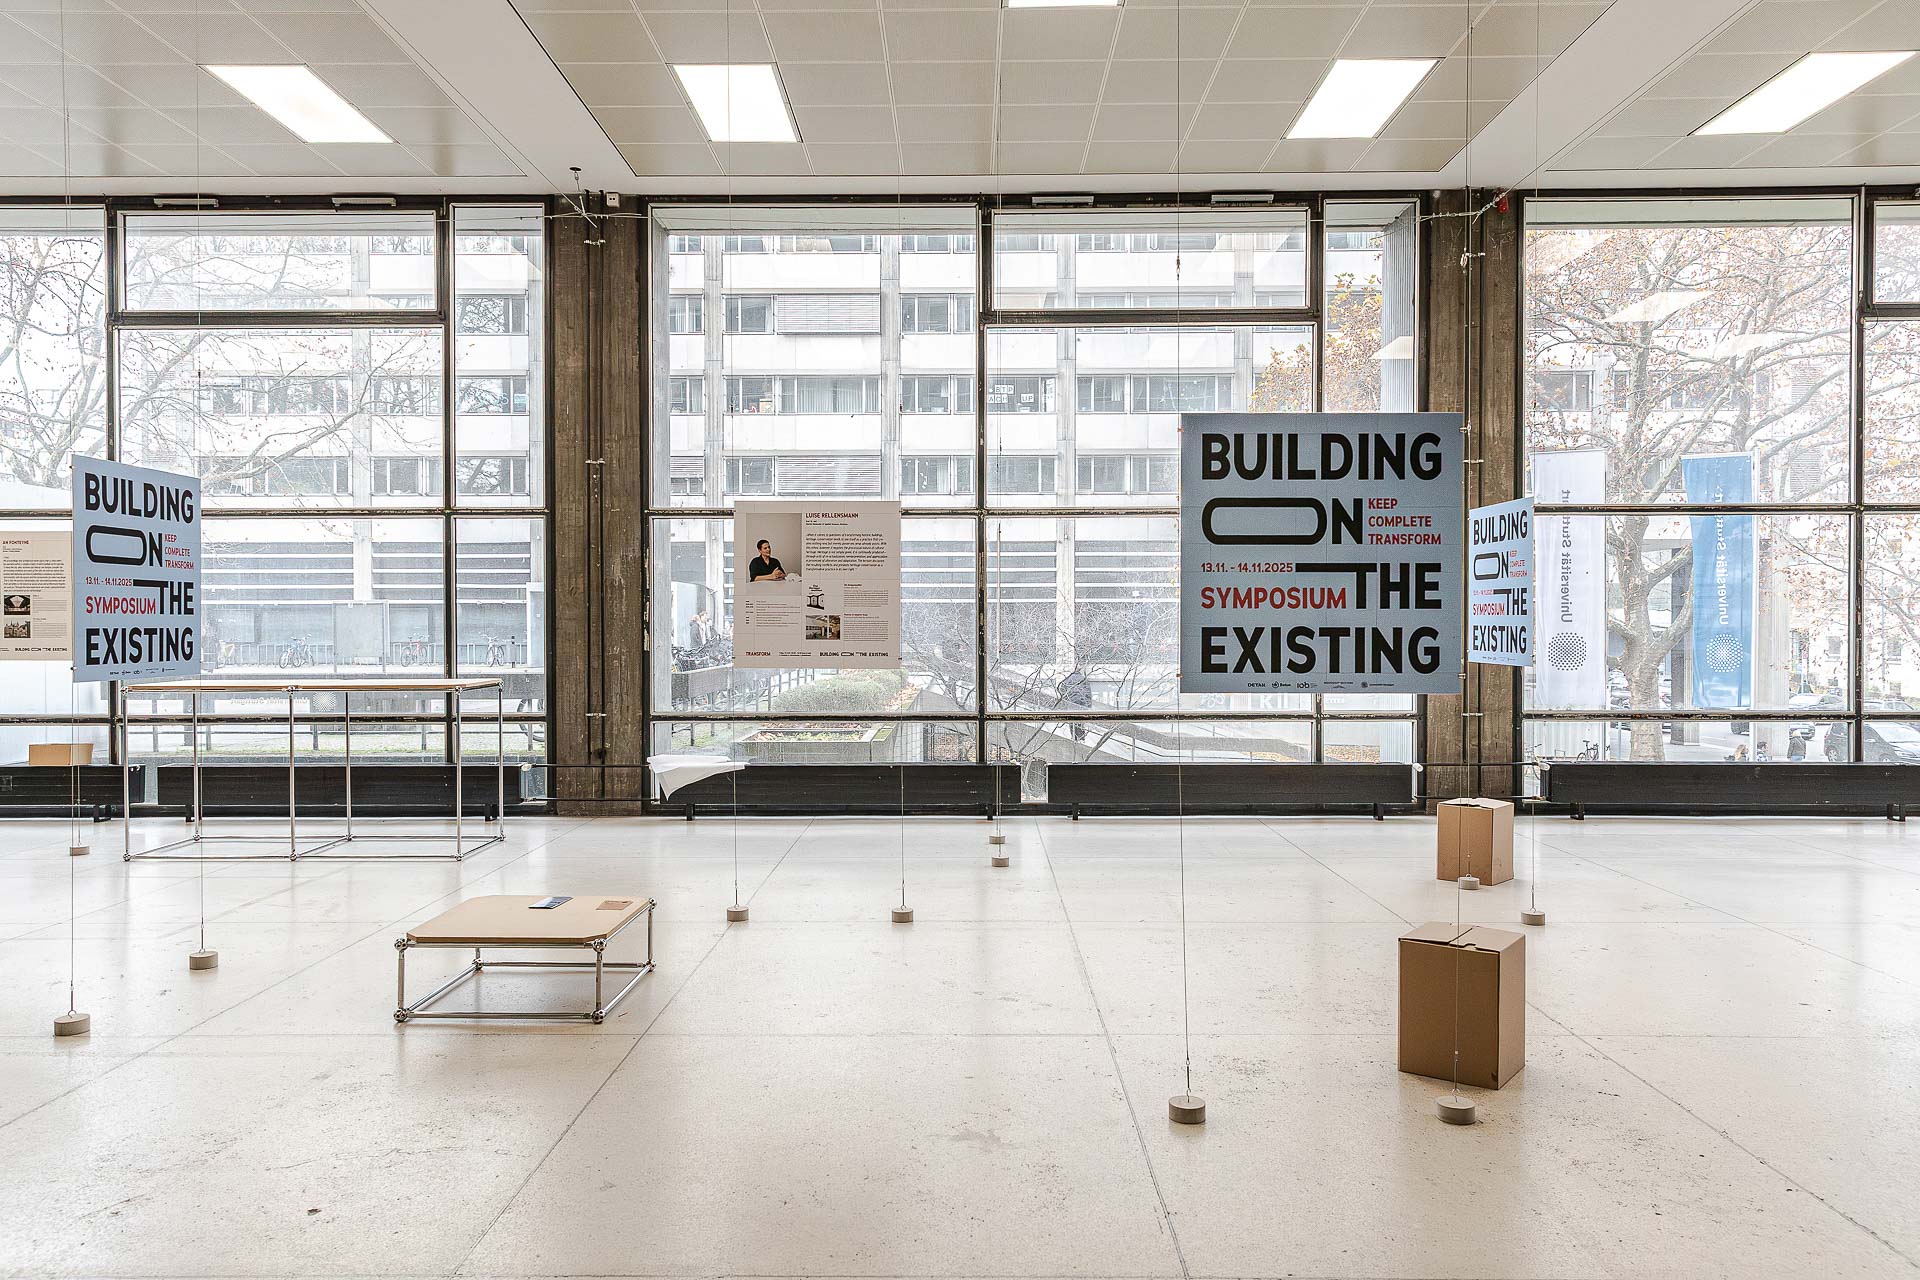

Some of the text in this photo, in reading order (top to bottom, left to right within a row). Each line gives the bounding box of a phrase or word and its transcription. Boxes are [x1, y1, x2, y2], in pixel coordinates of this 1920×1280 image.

[1201, 433, 1442, 480] BUILDING
[85, 472, 194, 524] BUILDING
[1368, 498, 1398, 509] KEEP
[1201, 497, 1363, 545] ON
[1368, 516, 1432, 527] COMPLETE
[1473, 510, 1528, 545] BUILDING
[86, 524, 163, 567] ON
[165, 533, 177, 543] KEEP
[165, 546, 191, 557] COMPLETE
[1368, 534, 1442, 545] TRANSFORM
[165, 559, 194, 570] TRANSFORM
[1201, 562, 1228, 573] 13.11.
[1237, 562, 1293, 573] 14.11.2025
[1473, 551, 1509, 580] ON
[104, 577, 133, 587] 14.11.2025
[1295, 562, 1442, 609] THE
[86, 596, 156, 615] SYMPOSIUM
[133, 579, 194, 615] THE
[1201, 587, 1347, 609] SYMPOSIUM
[1473, 602, 1505, 616] SYMPOSIUM
[1493, 587, 1528, 616] THE
[86, 627, 194, 666] EXISTING
[1201, 626, 1440, 674] EXISTING
[1473, 625, 1527, 654] EXISTING
